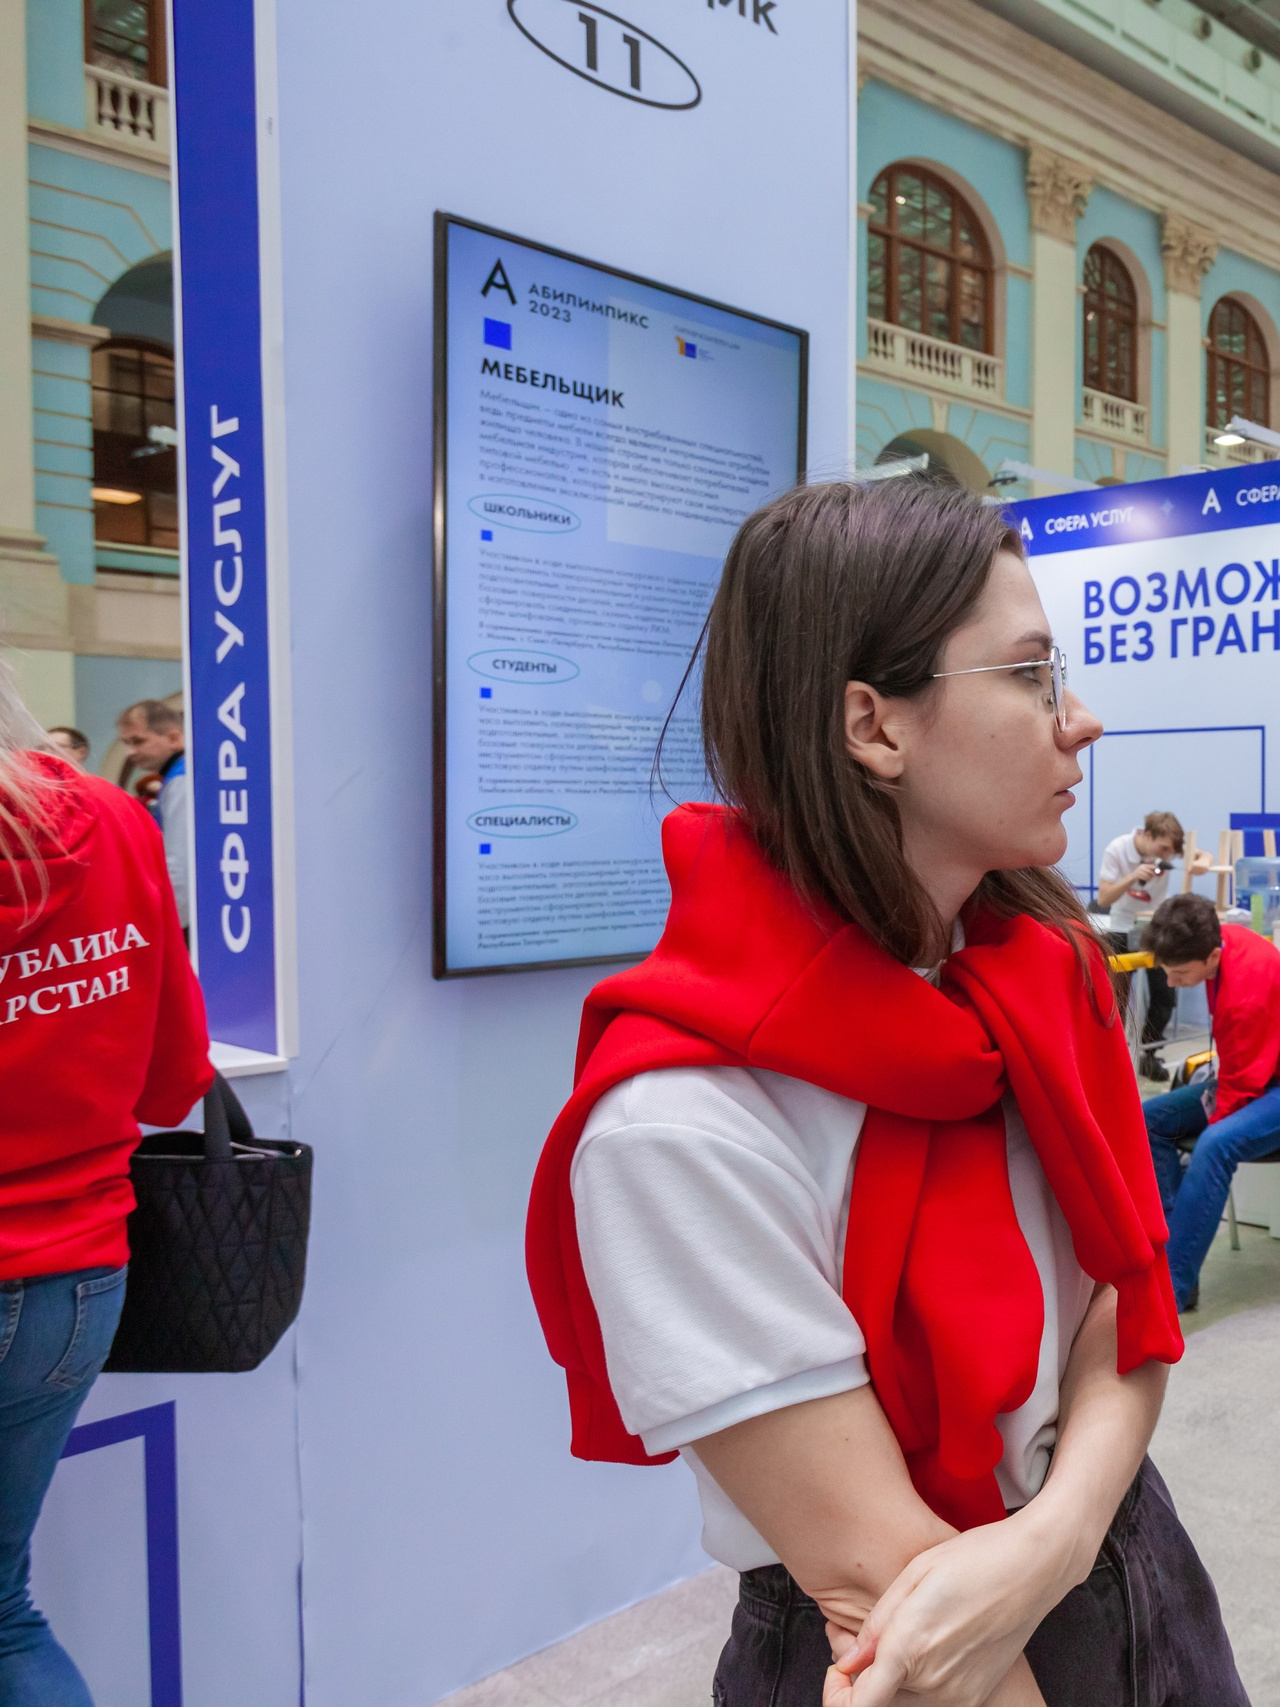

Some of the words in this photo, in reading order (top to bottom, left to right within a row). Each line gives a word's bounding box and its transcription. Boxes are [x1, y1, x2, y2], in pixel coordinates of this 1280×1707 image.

[578, 11, 641, 91] 11
[529, 282, 649, 329] АБИЛИМПИКС
[529, 300, 572, 323] 2023
[481, 357, 625, 408] МЕБЕЛЬЩИК
[210, 405, 244, 664] УСЛУГ
[484, 502, 571, 526] ШКОЛЬНИКИ
[1045, 514, 1089, 535] СФЕРА
[1090, 506, 1134, 528] УСЛУГ
[1084, 621, 1154, 665] БЕЗ
[492, 658, 557, 674] СТУДЕНТЫ
[217, 682, 251, 953] СФЕРА
[475, 815, 571, 829] СПЕЦИАЛИСТЫ
[0, 966, 131, 1025] РСТАН
